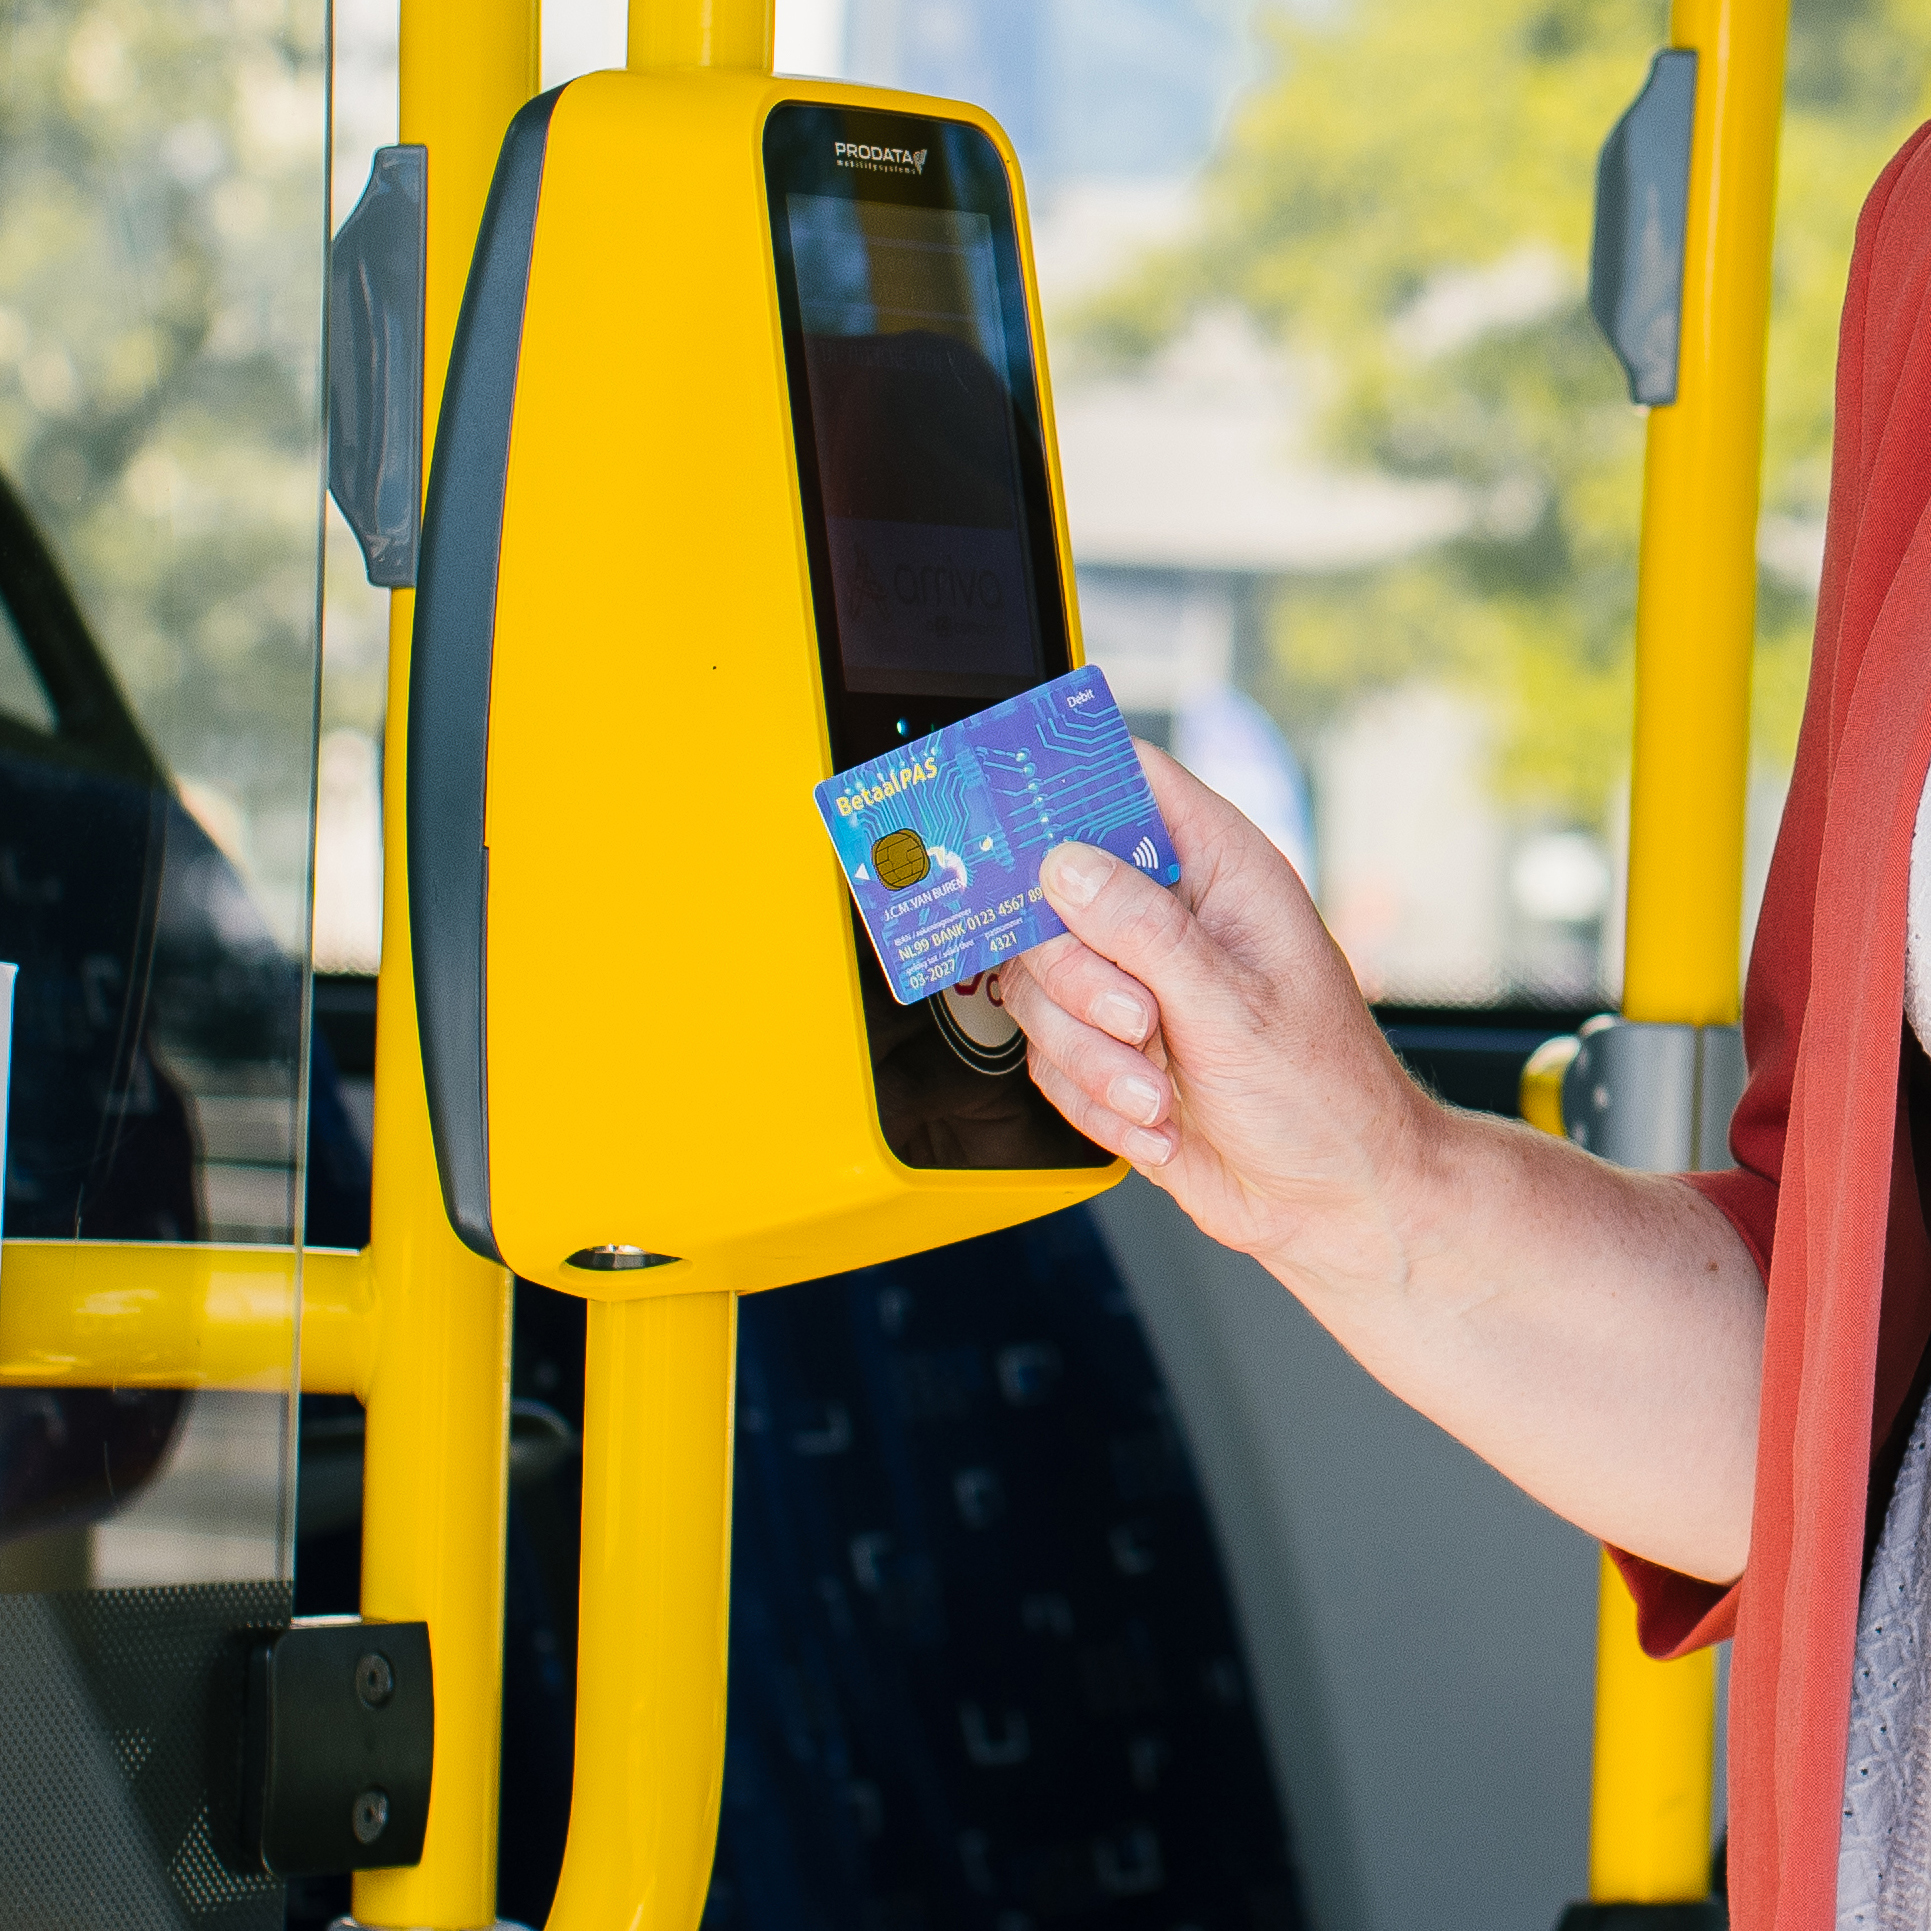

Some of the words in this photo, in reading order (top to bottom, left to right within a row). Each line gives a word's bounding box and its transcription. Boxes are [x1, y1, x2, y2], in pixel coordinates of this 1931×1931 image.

[834, 141, 914, 165] PRODATA
[1066, 688, 1096, 708] Debit
[835, 756, 938, 817] BetaalPAS
[898, 938, 931, 962] NL99
[930, 922, 967, 947] BANK
[966, 907, 997, 931] 0123
[998, 892, 1025, 917] 4567
[1027, 886, 1044, 903] 89
[989, 930, 1018, 952] 4321
[909, 957, 957, 990] 03-2027
